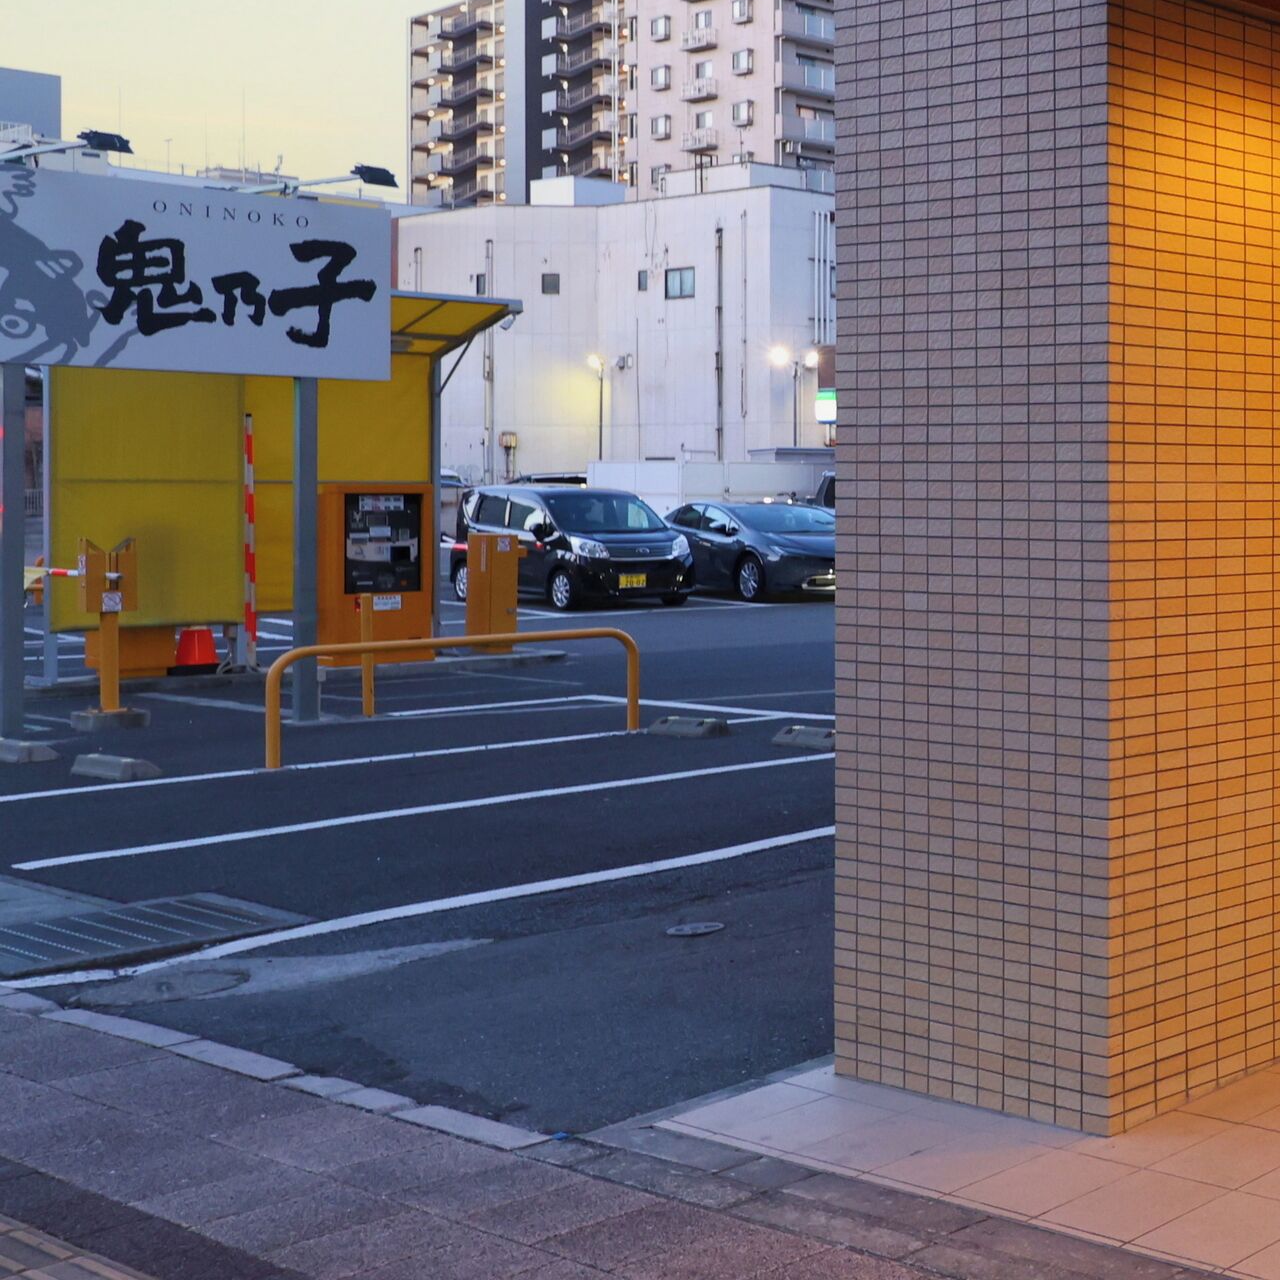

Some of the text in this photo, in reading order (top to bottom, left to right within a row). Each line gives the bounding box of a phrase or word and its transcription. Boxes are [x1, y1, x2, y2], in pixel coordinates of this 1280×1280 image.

[153, 199, 309, 229] ONINOKO
[96, 219, 377, 348] 鬼乃子
